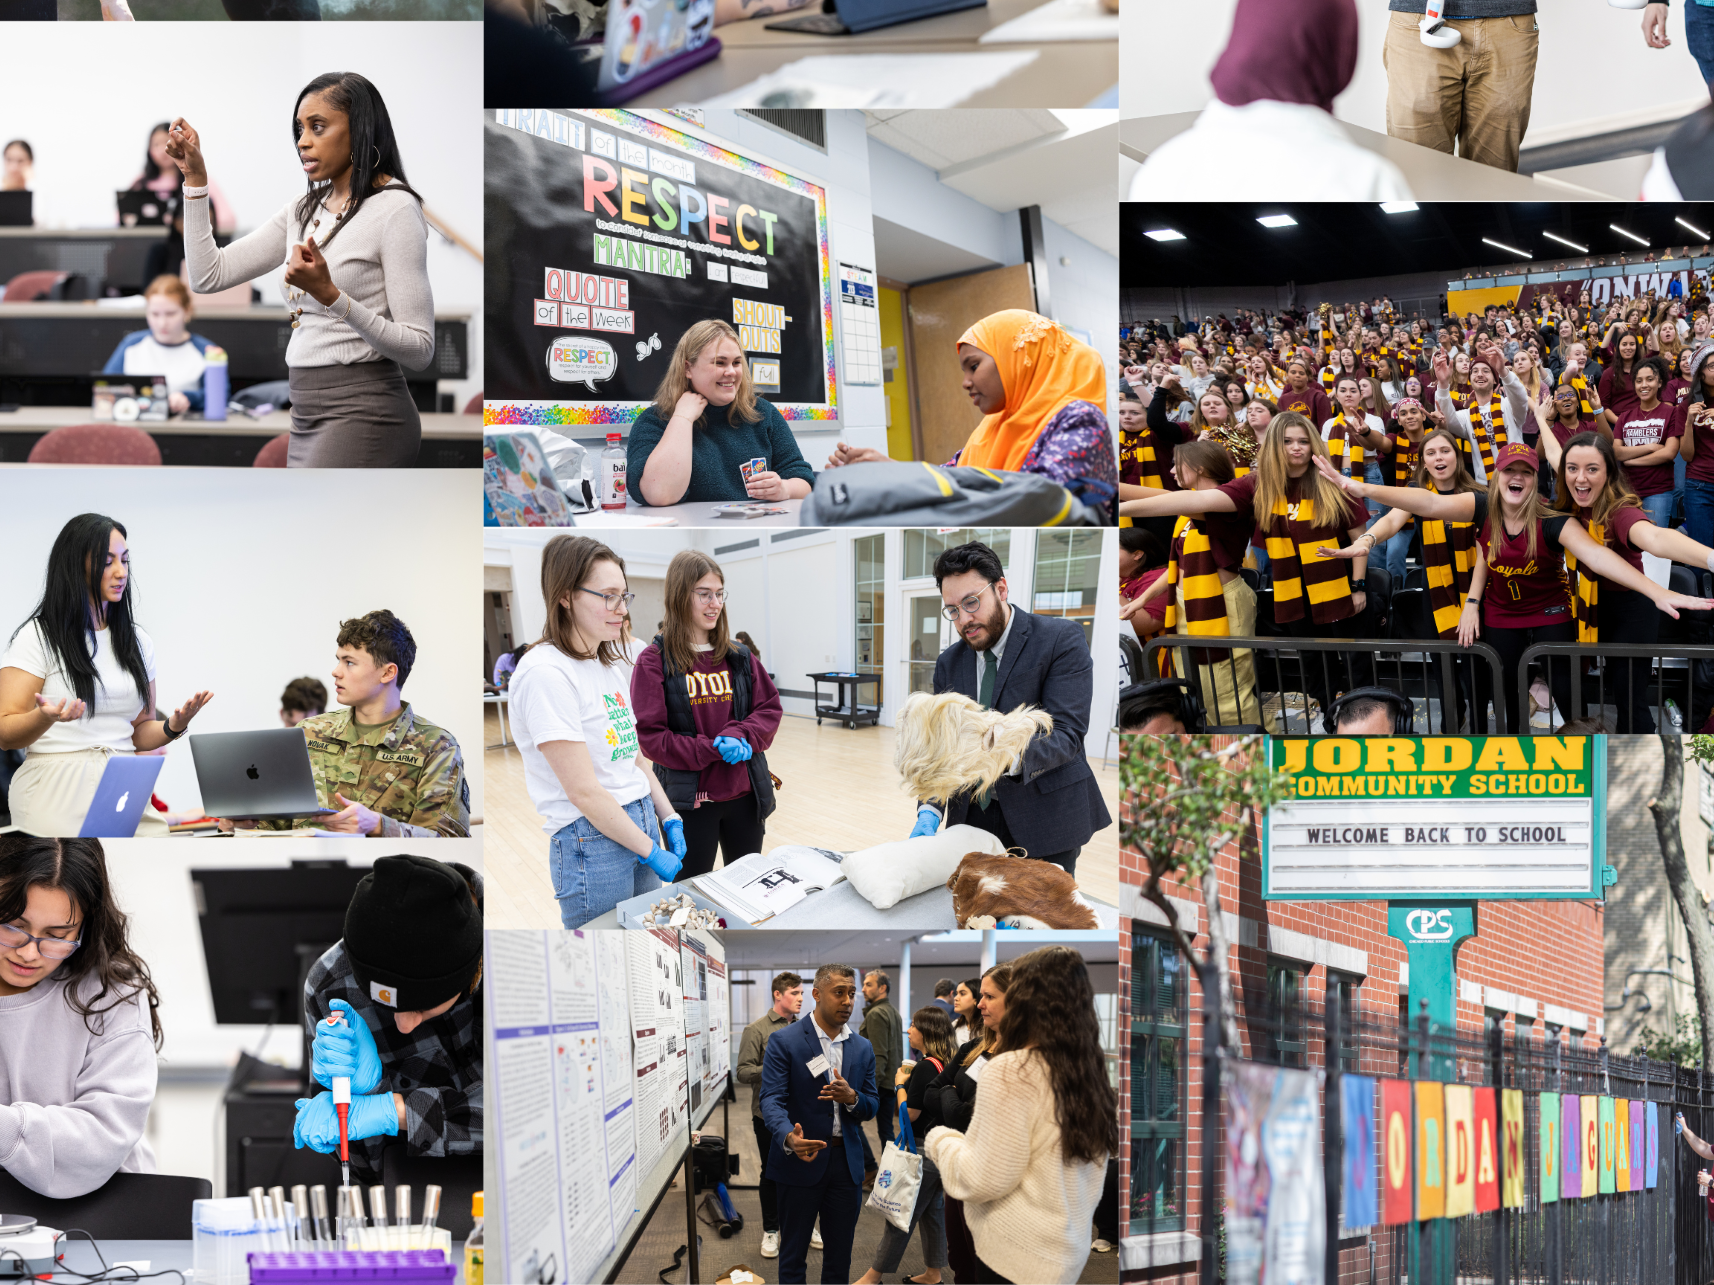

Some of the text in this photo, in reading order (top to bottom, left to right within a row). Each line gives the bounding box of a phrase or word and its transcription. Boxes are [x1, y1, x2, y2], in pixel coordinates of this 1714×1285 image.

[595, 135, 610, 150] of
[623, 141, 644, 163] the
[651, 157, 693, 181] month
[582, 154, 777, 255] RESPECT
[594, 234, 691, 278] MANTRA:
[731, 270, 767, 286] respectful
[847, 270, 867, 282] STEAM
[547, 270, 627, 308] QUOTE
[538, 306, 631, 329] of the Week
[734, 299, 792, 329] SHOUT-
[741, 326, 780, 353] OUTS
[554, 348, 611, 366] RESPECT.
[759, 368, 774, 383] full
[612, 461, 626, 473] bai
[1487, 558, 1539, 575] Loyola
[1507, 579, 1521, 600] 1
[603, 693, 617, 707] No
[612, 717, 633, 732] what
[308, 740, 329, 749] NOVAK
[618, 730, 637, 745] keep
[397, 755, 419, 764] ARMY
[1279, 735, 1583, 772] JORDAN
[1287, 773, 1585, 796] COMMUNITY SCHOOL
[1307, 826, 1566, 844] WELCOME BACK TO SCHOOL
[1406, 909, 1453, 939] CPS
[1352, 1109, 1656, 1191] JORDAN JAGUARS
